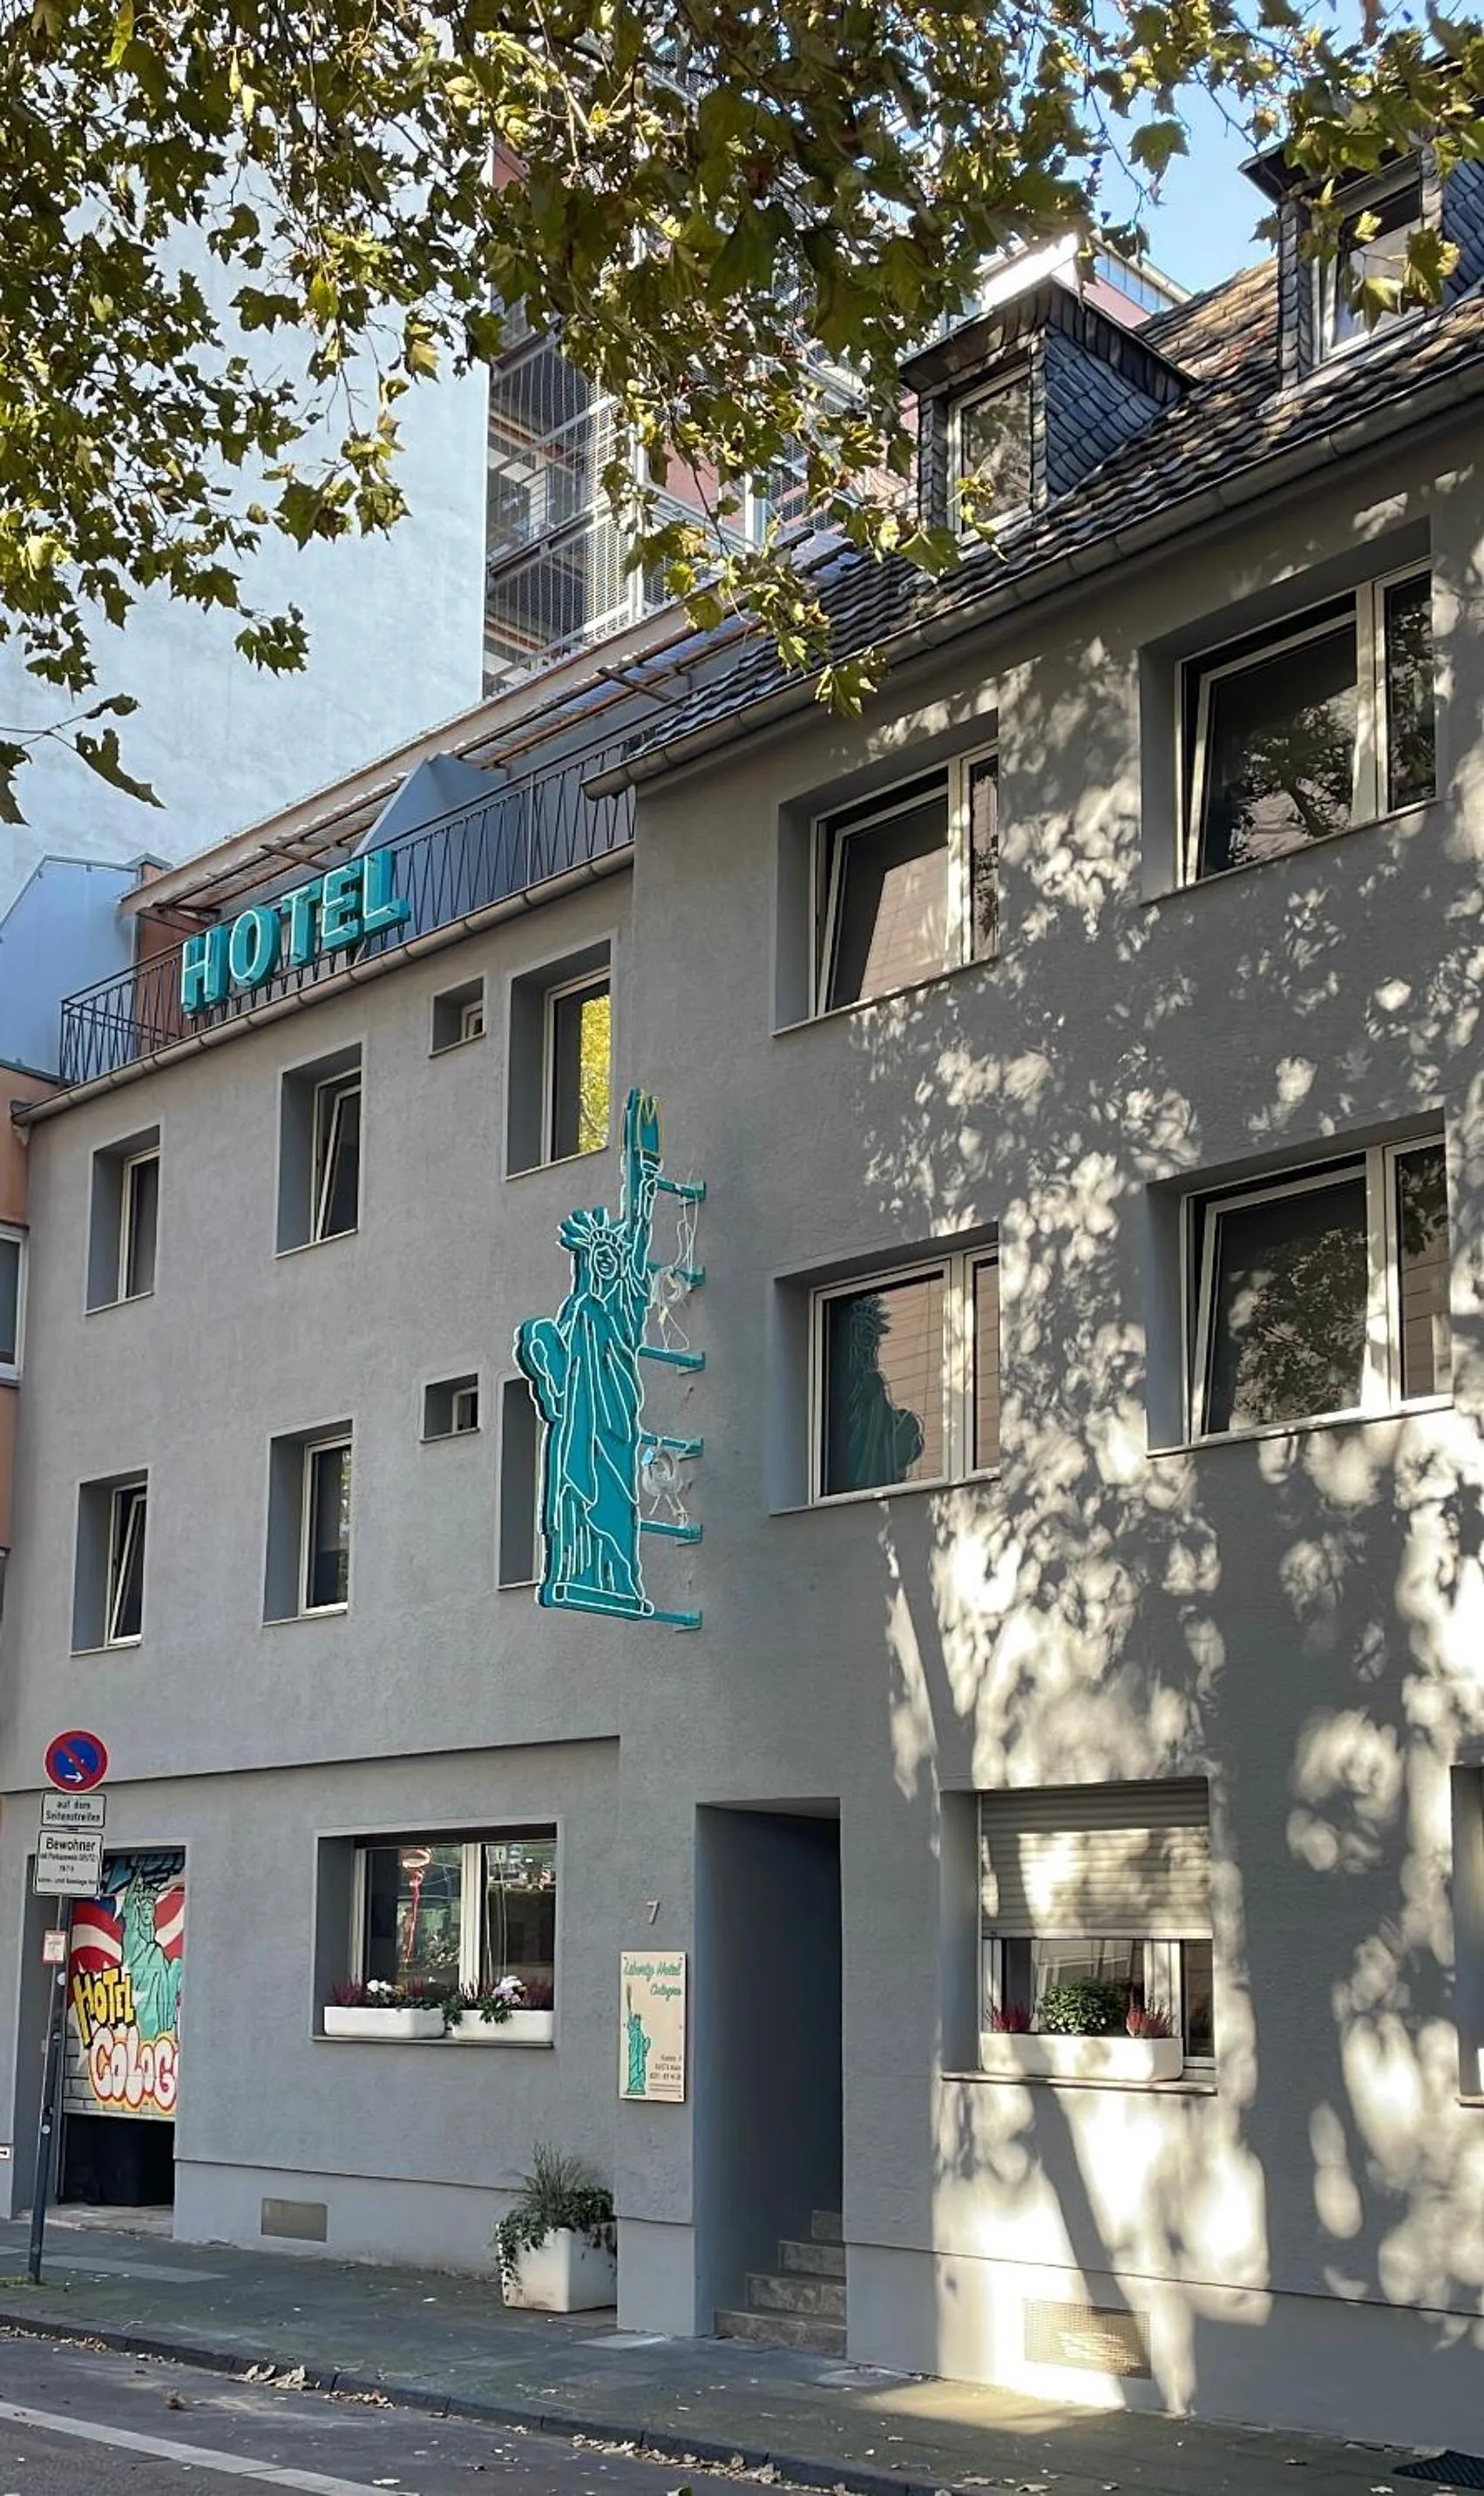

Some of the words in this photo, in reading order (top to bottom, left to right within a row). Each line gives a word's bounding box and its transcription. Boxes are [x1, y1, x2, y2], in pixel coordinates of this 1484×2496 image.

[180, 848, 411, 1013] HOTEL
[46, 1837, 96, 1851] Bewohner
[647, 1900, 660, 1925] 7
[72, 1966, 136, 2049] HOTEL
[90, 2025, 179, 2111] COLOG
